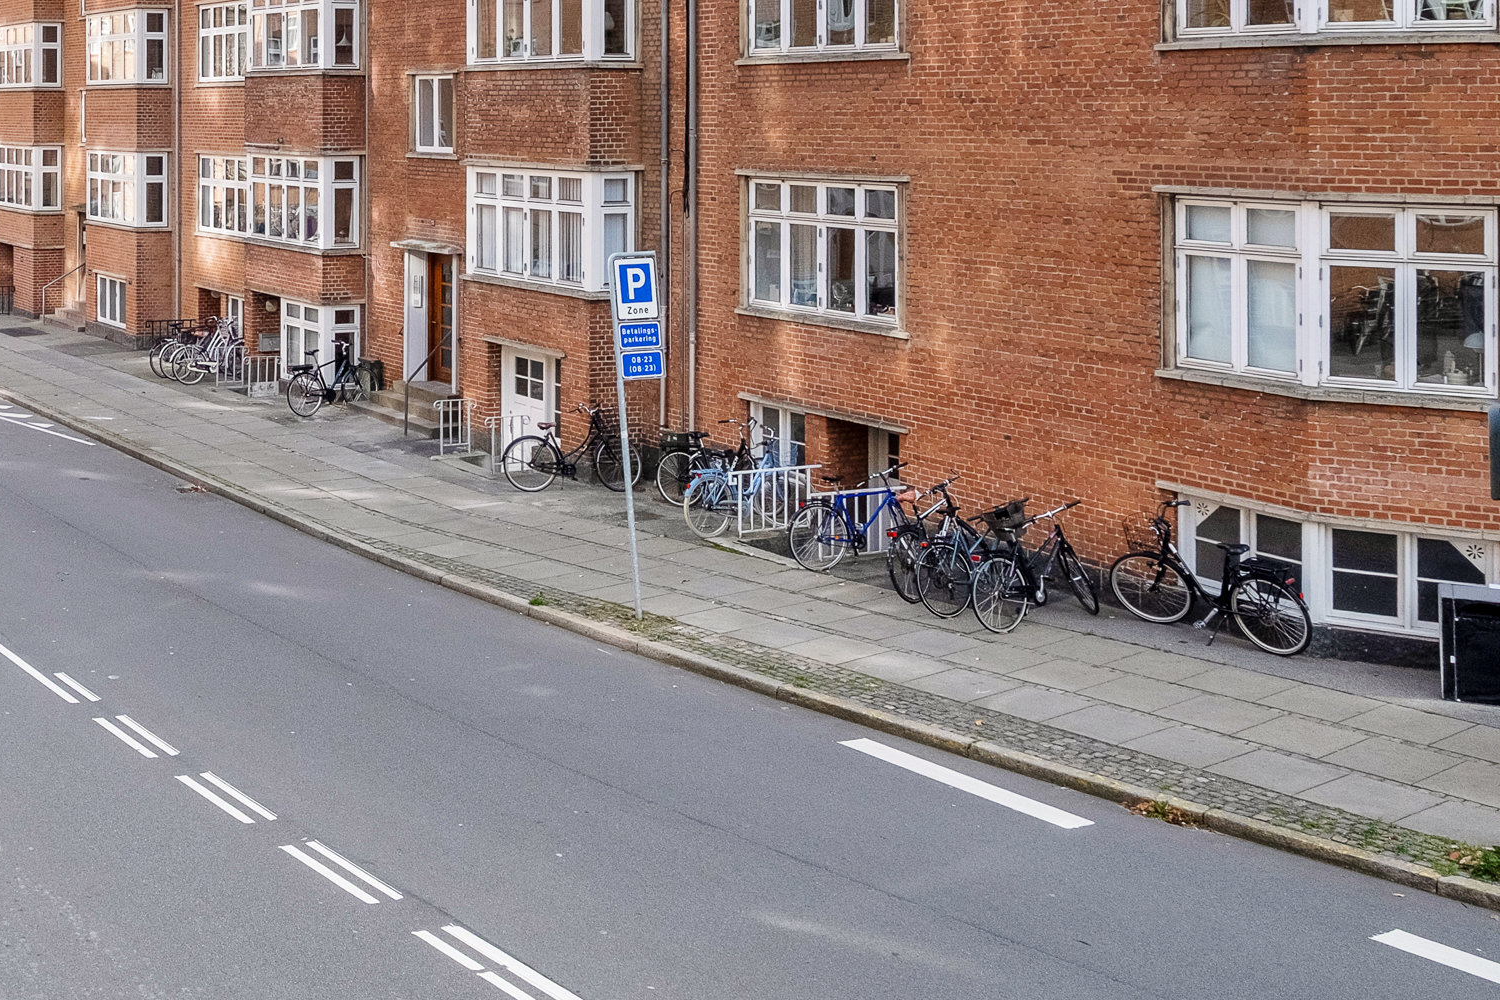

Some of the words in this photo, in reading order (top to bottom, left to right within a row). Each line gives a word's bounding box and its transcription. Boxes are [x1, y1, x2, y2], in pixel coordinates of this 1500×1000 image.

[626, 267, 646, 300] P
[627, 306, 649, 315] Zone
[621, 327, 657, 336] Betalings-
[623, 334, 657, 344] parkering
[631, 355, 653, 364] 08-23
[629, 363, 657, 373] (08-23)
